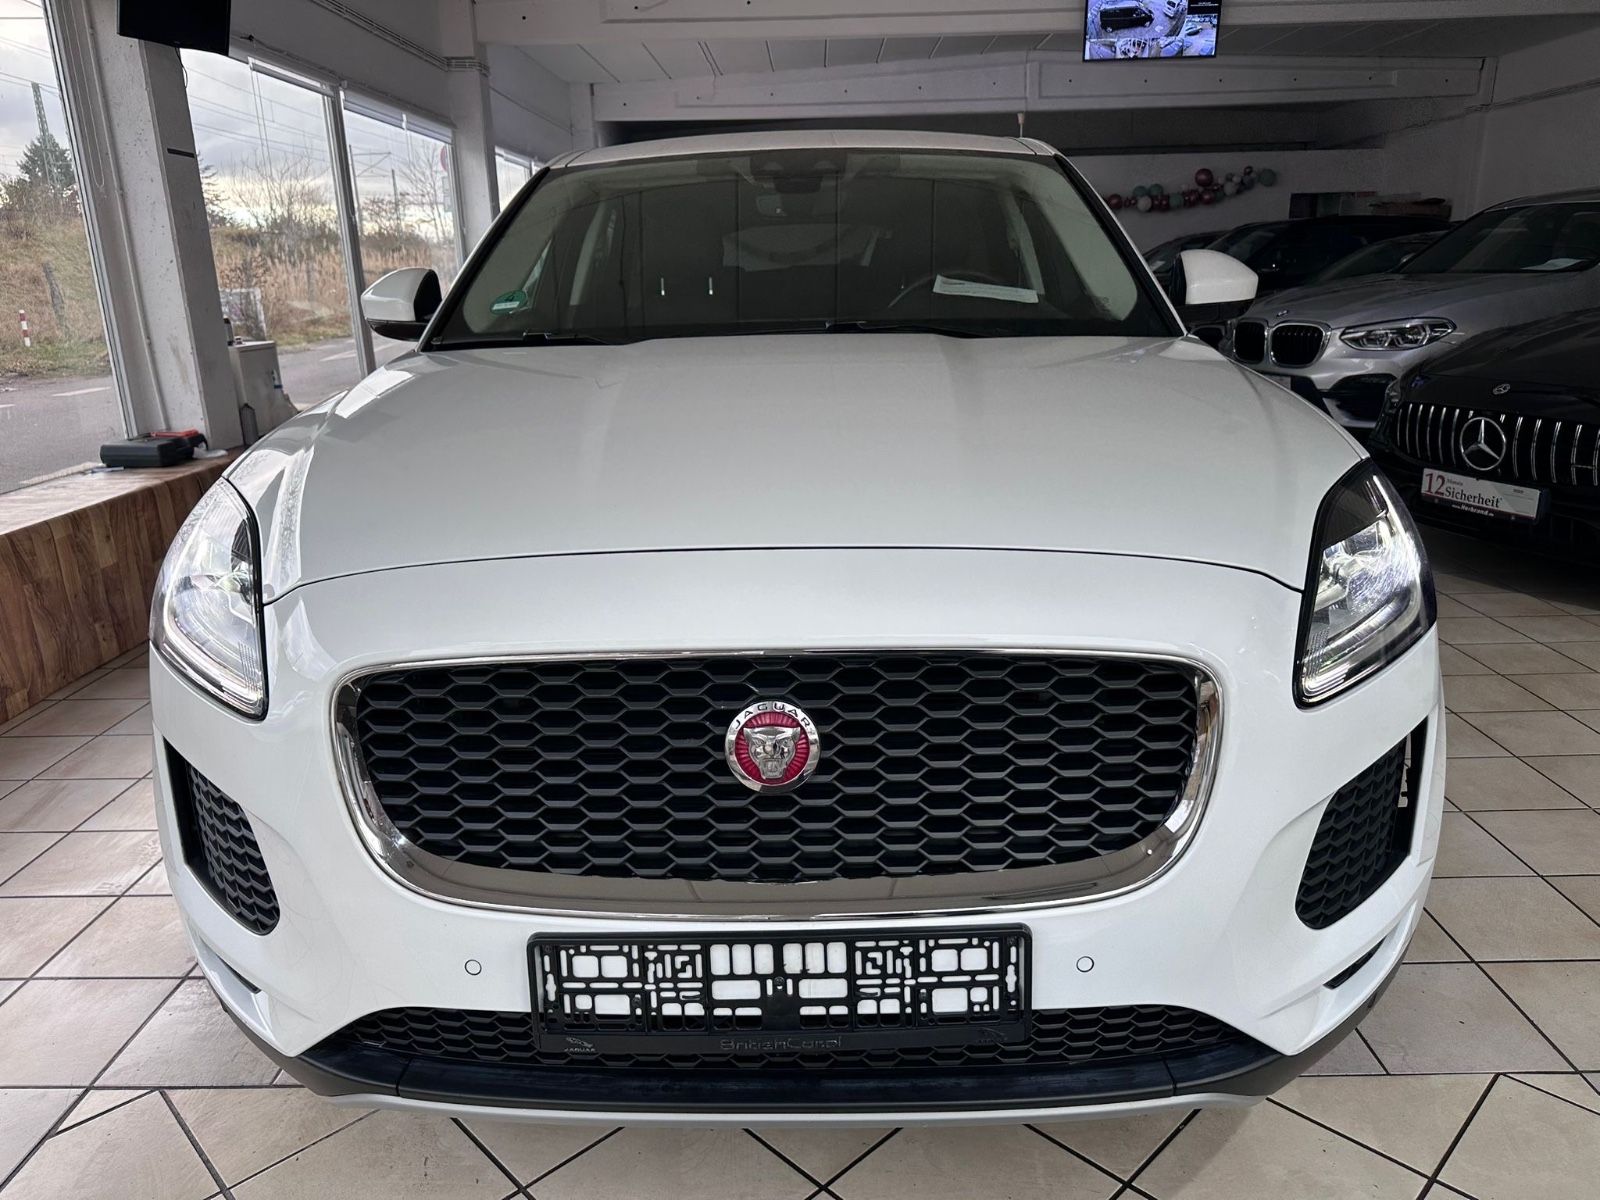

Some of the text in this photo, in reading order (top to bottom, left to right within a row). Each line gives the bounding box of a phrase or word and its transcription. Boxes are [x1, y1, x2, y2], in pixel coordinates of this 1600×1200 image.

[1424, 472, 1446, 497] 12
[1445, 486, 1501, 508] Sicherheit
[735, 703, 811, 729] JAGUAR
